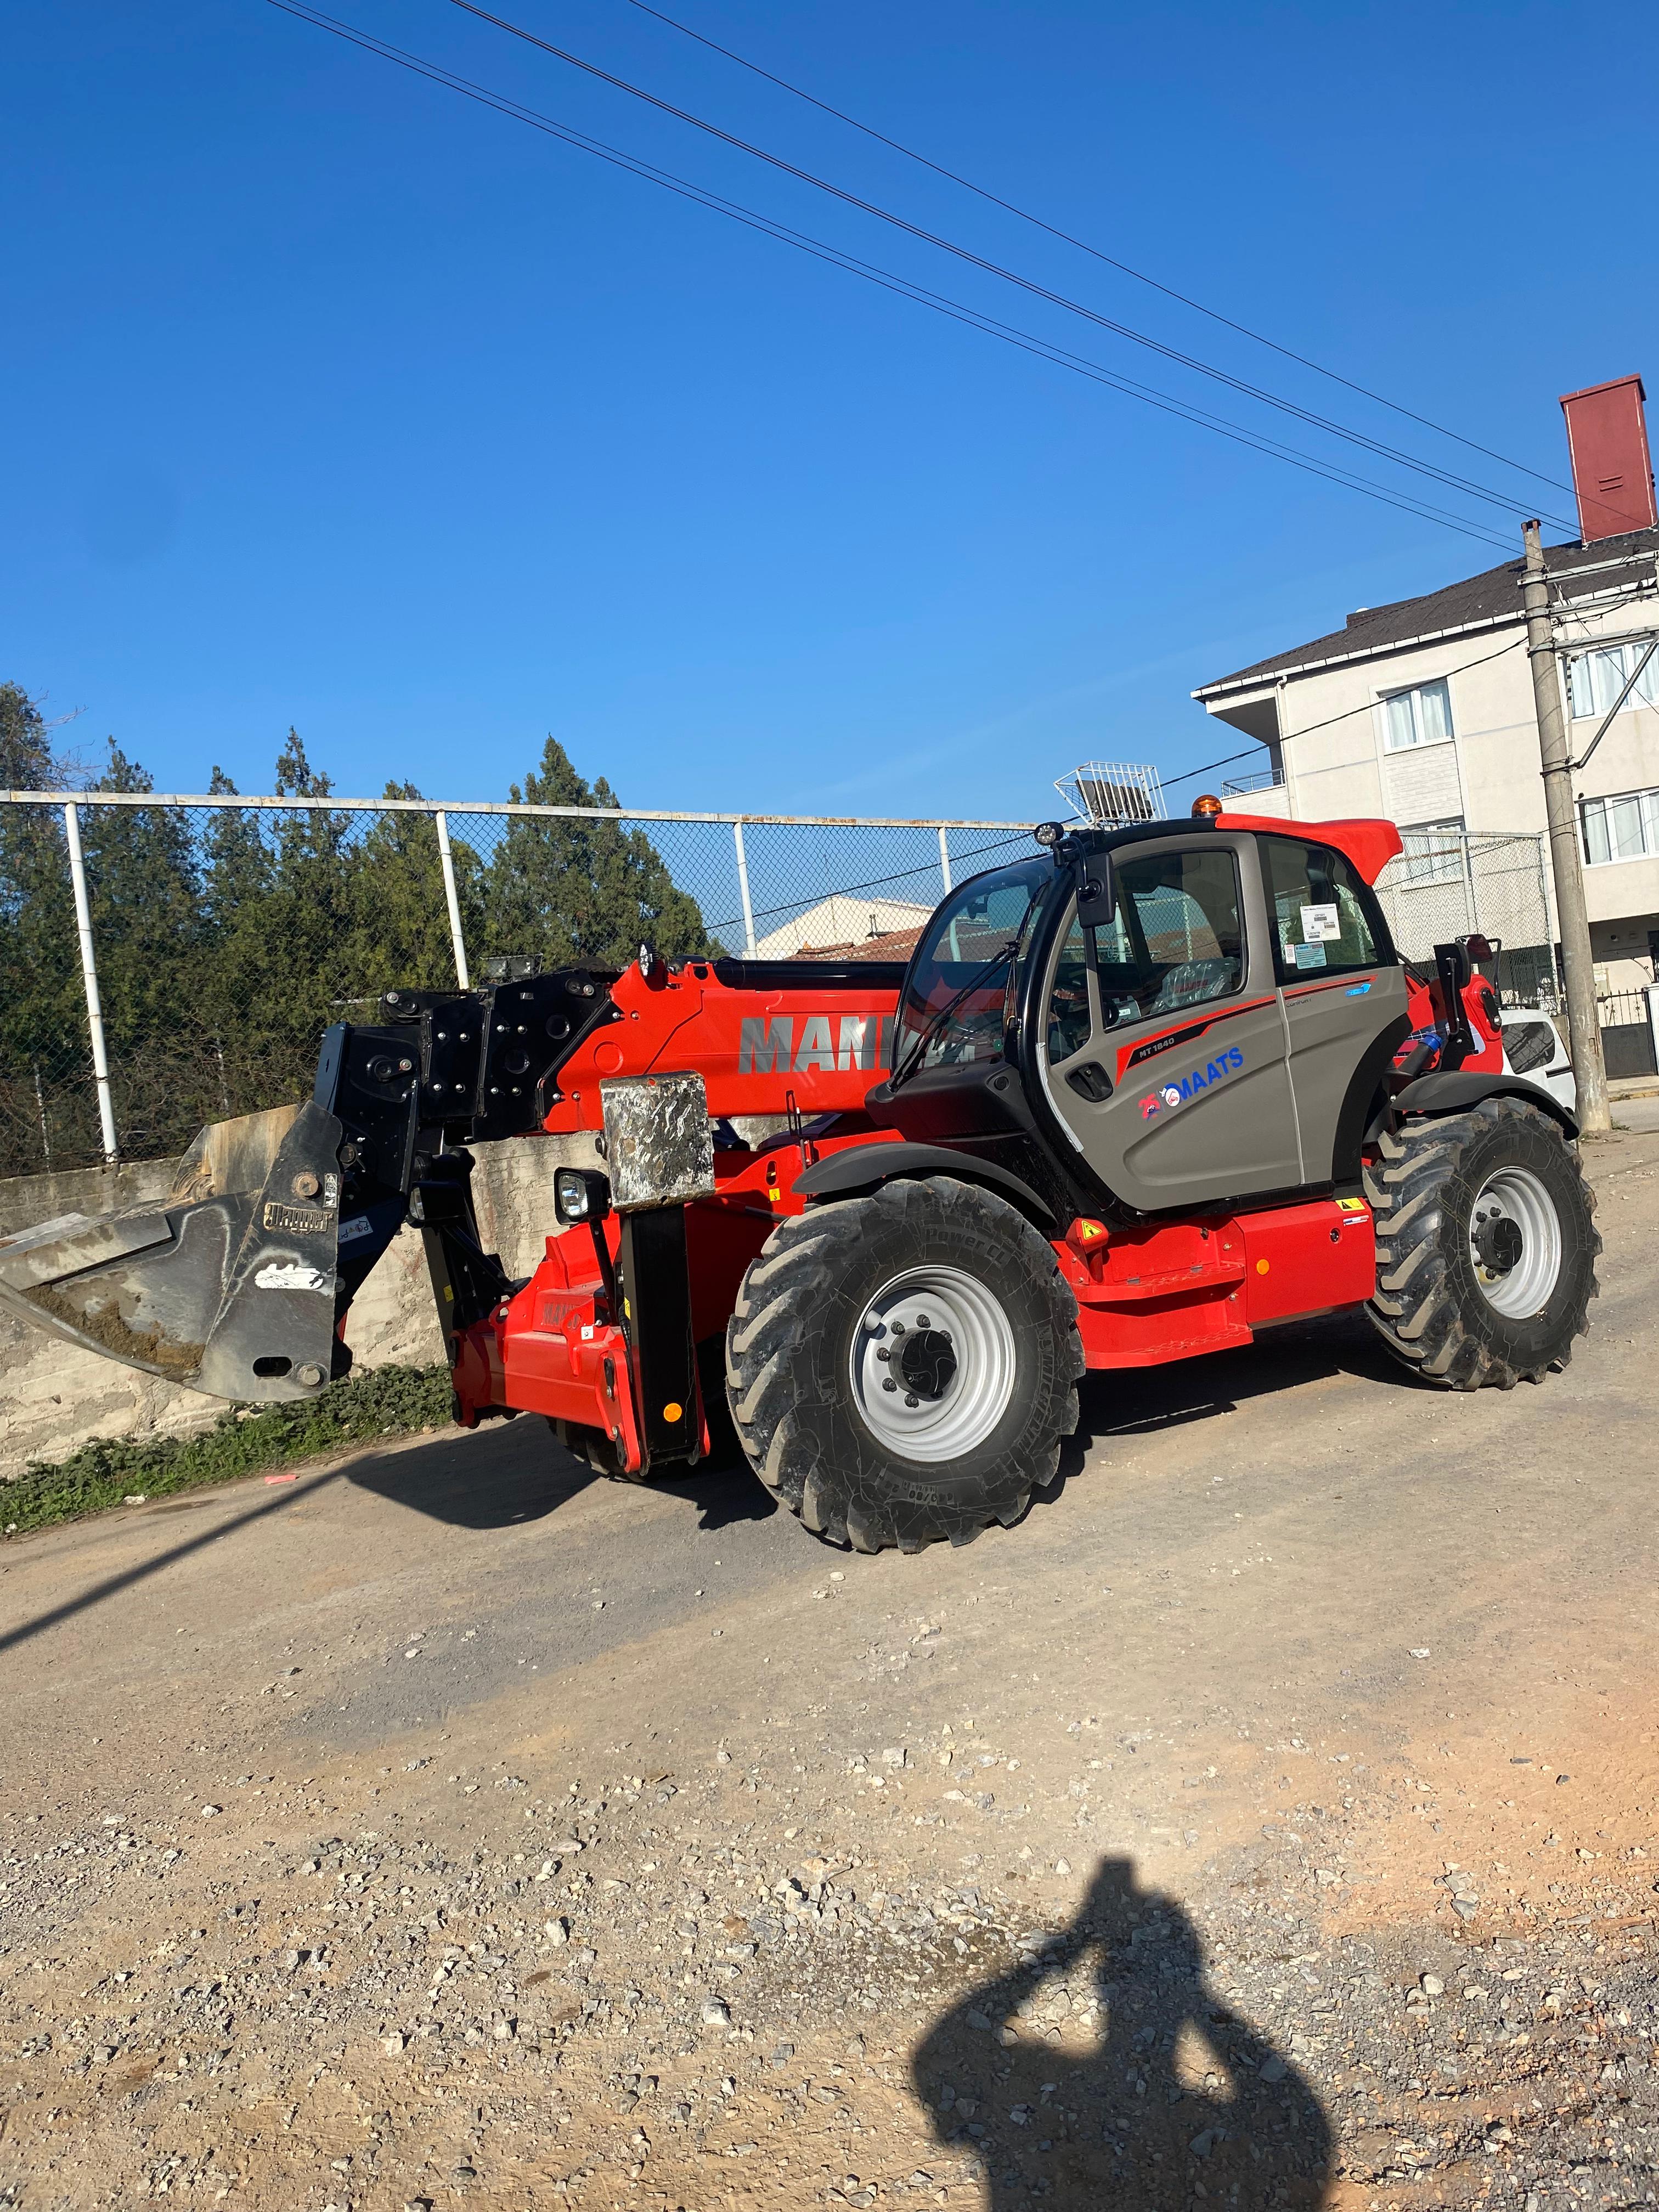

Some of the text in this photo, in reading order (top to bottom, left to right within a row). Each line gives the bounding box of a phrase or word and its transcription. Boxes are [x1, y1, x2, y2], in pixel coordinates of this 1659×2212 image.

[738, 1017, 896, 1074] MANI
[1139, 1037, 1175, 1058] MT 1840
[926, 1228, 985, 1250] Power
